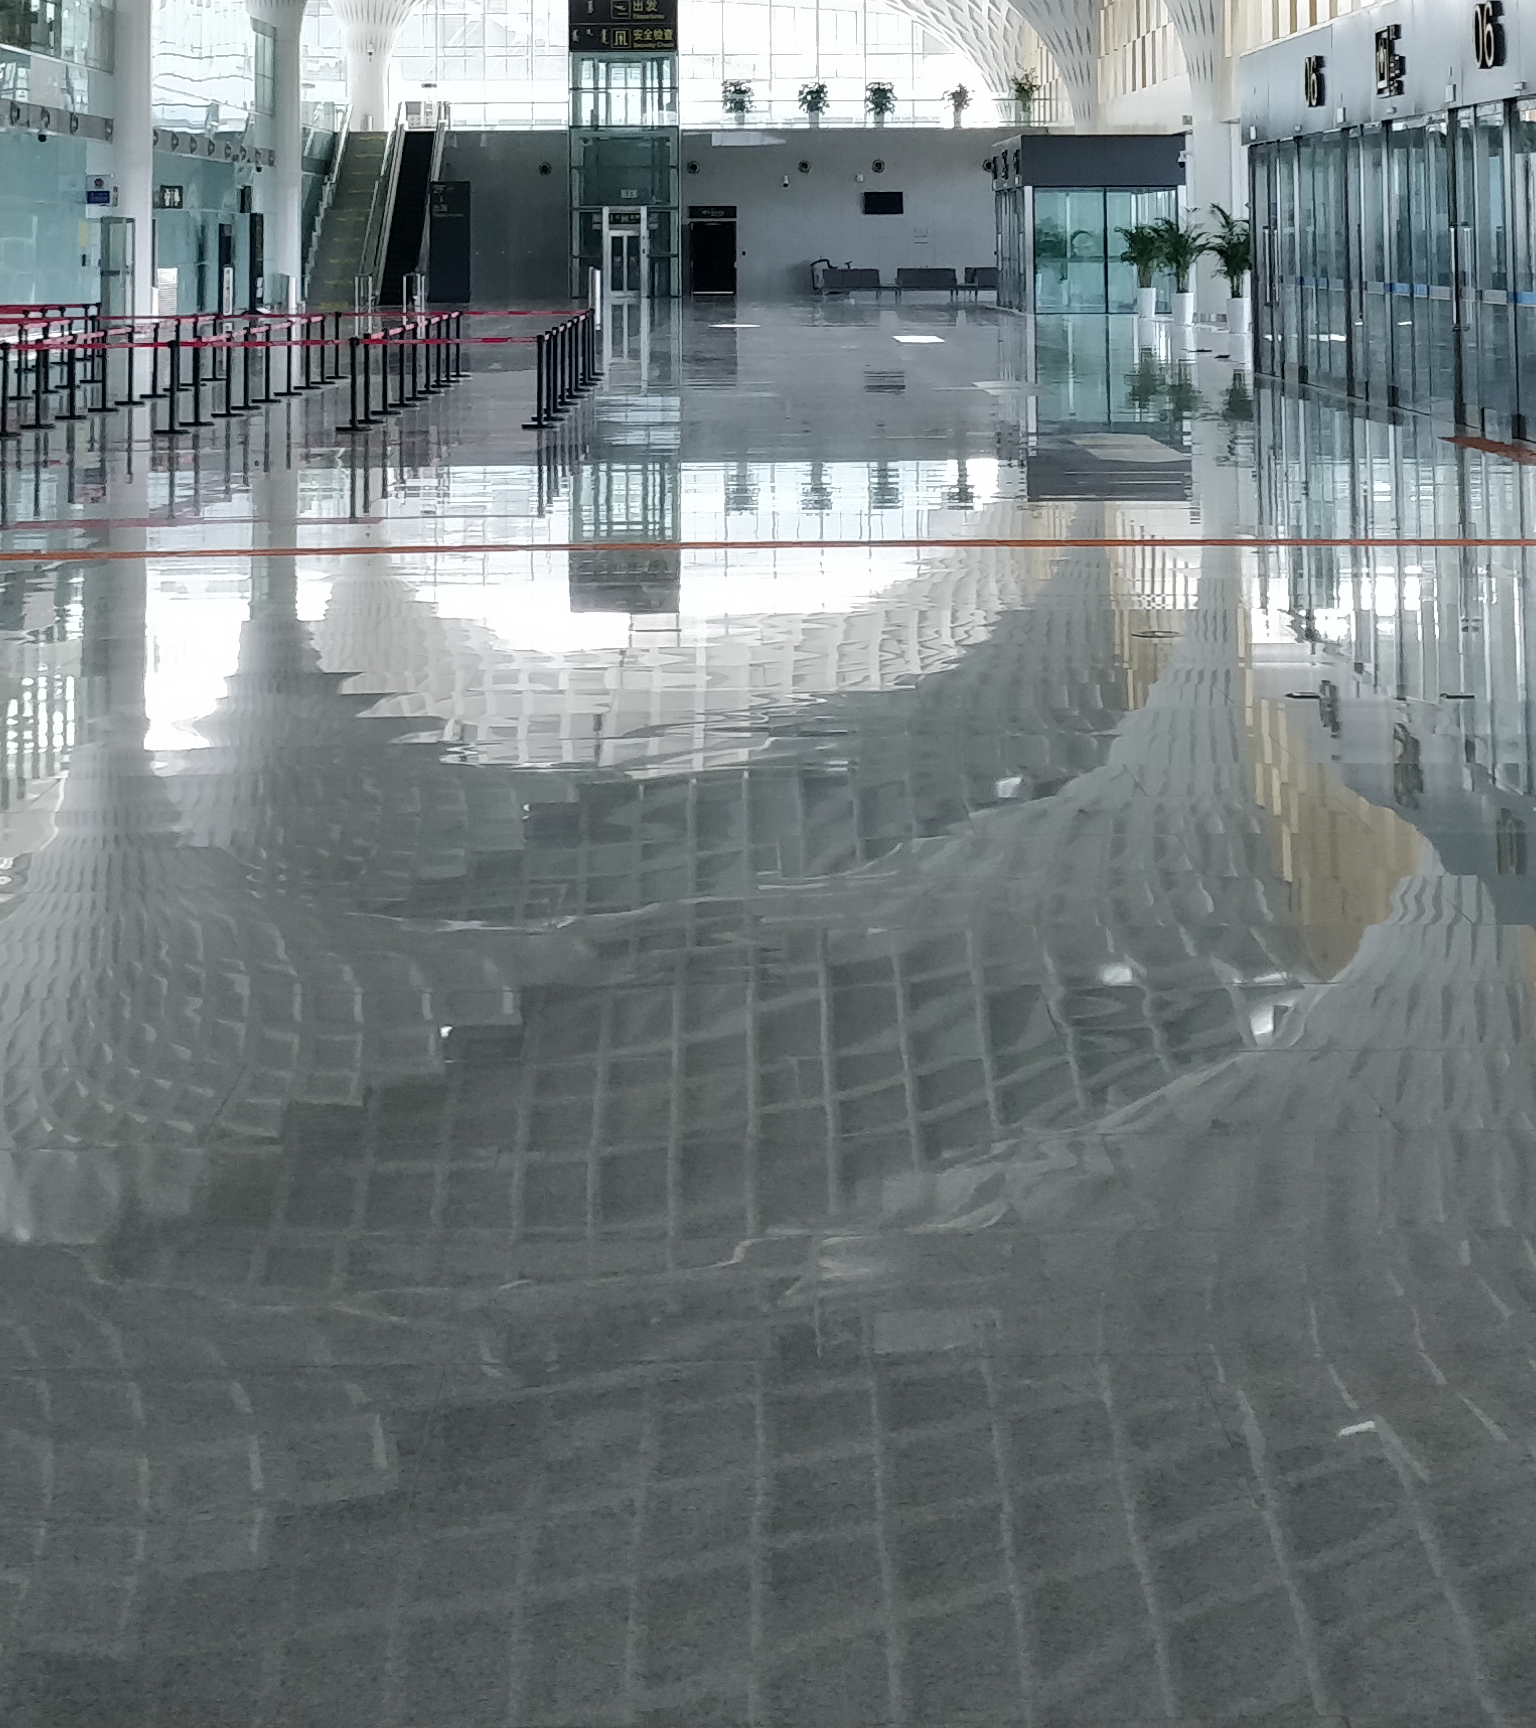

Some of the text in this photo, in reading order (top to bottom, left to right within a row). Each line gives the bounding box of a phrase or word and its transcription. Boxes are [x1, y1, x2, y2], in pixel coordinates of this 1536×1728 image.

[633, 0, 658, 12] 出发
[633, 28, 673, 41] 安全检查
[1473, 0, 1501, 70] 06
